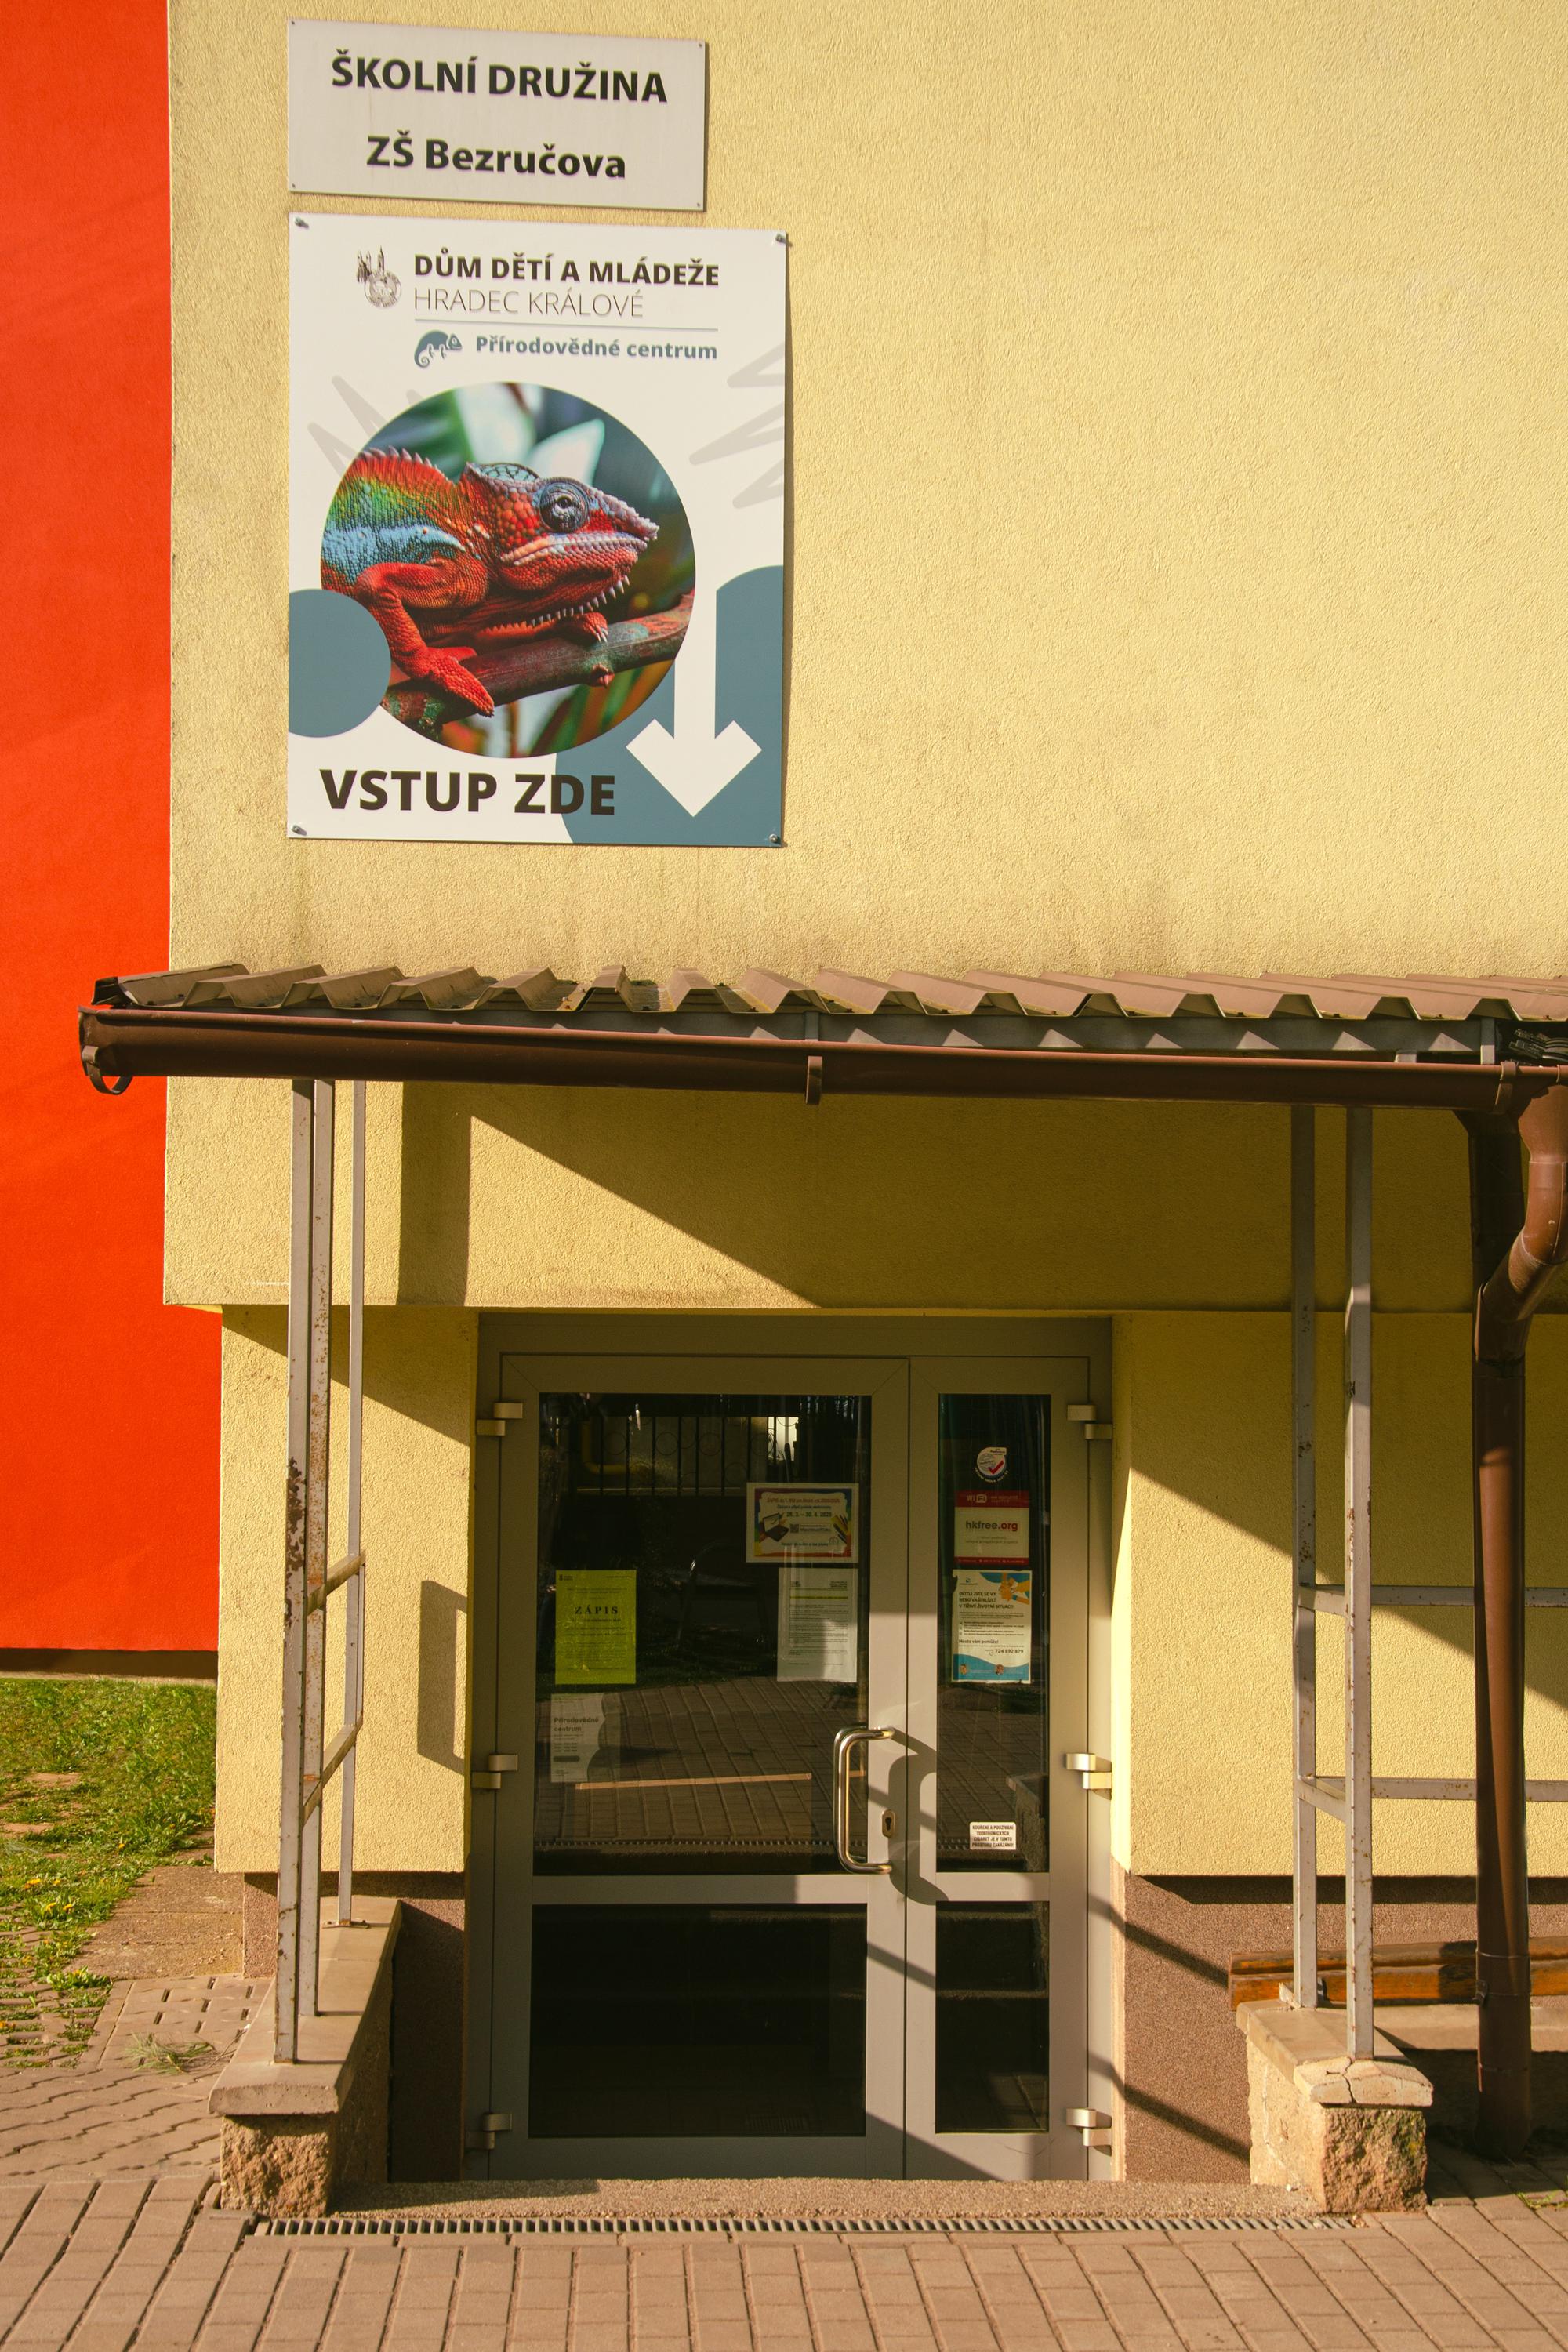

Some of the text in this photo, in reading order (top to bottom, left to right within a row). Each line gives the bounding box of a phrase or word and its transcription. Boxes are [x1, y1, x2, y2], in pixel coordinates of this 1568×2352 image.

[332, 49, 668, 103] ŠKOLNÍ DRUŽINA
[366, 130, 626, 179] ZŠ Bezručova
[415, 248, 719, 286] DŮM DĚTÍ A MLÁDEŽE
[415, 288, 644, 318] HRADEC KRÁLOVÉ
[476, 335, 717, 360] Přírodovědné centrum
[319, 768, 615, 815] VSTUP ZDE
[965, 1520, 1018, 1532] hkfree.org
[575, 1604, 619, 1615] ZÁPIS
